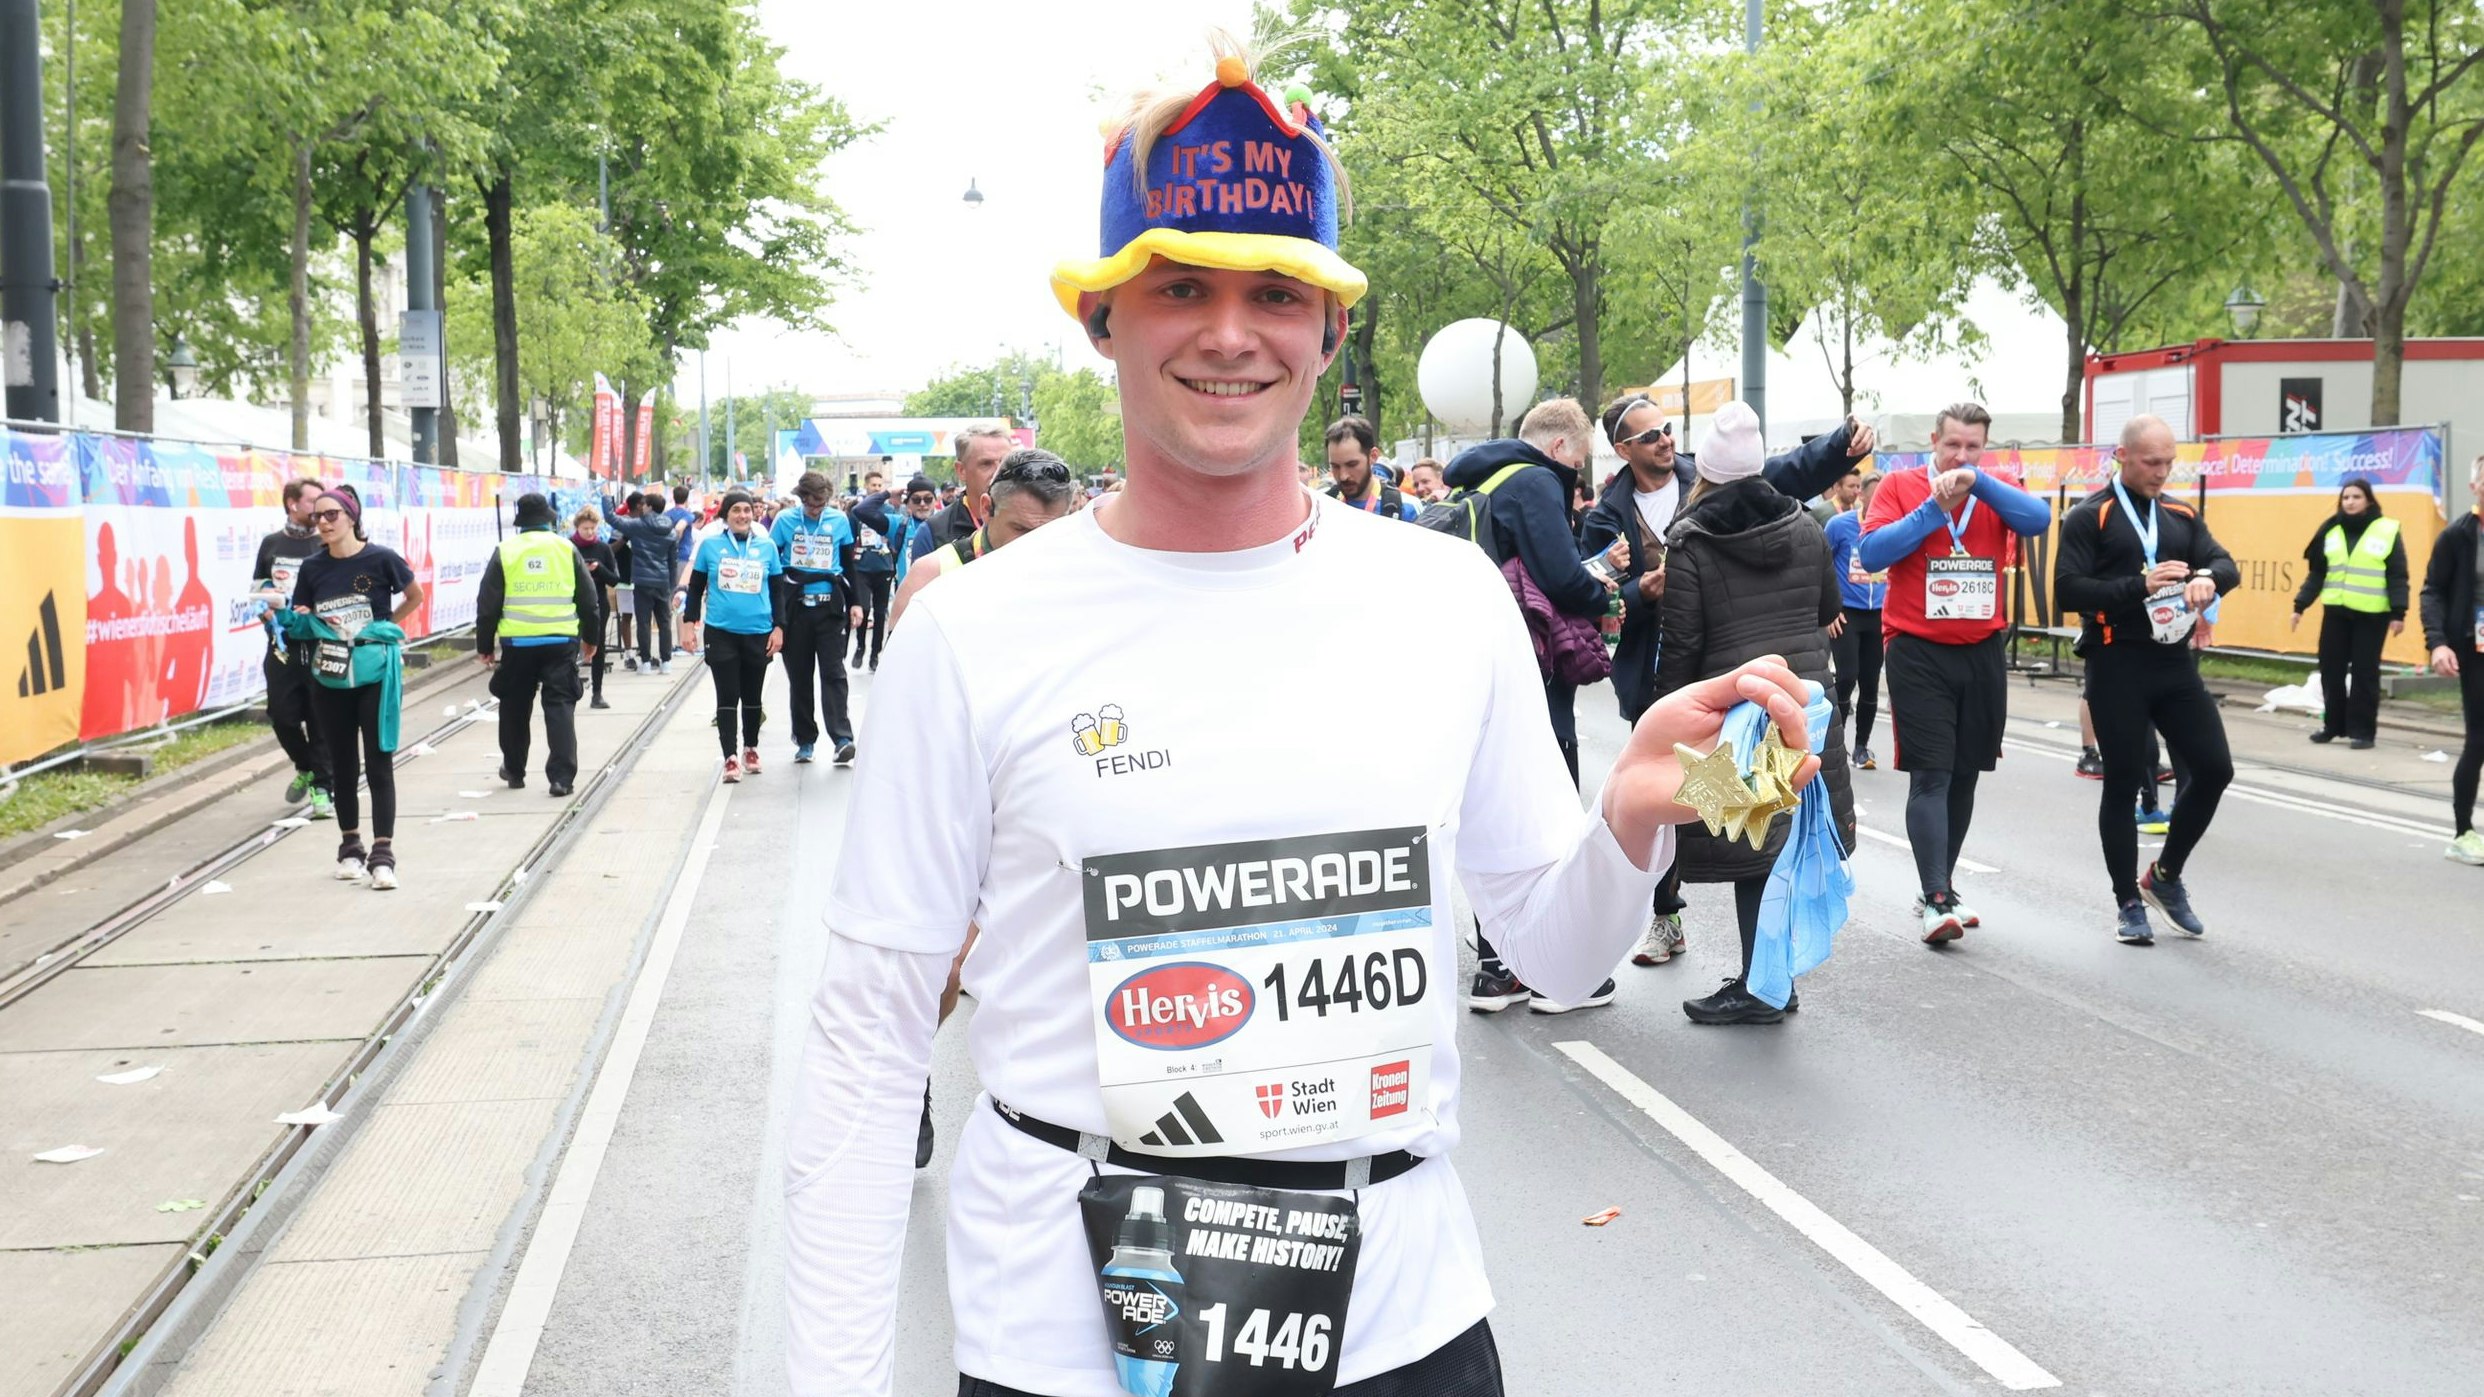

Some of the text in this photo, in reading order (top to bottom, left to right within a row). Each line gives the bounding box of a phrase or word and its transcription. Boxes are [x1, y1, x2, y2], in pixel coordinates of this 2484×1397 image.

[1172, 141, 1292, 178] IT'S MY
[1145, 178, 1315, 220] BIRTHDAY!
[8, 451, 36, 485] the
[2231, 451, 2328, 475] Determination!
[2333, 447, 2395, 471] Success!
[107, 455, 128, 485] Der
[131, 458, 175, 494] Anfang
[527, 560, 542, 569] 62
[1930, 560, 1993, 571] POWERADE
[2237, 559, 2293, 592] THIS
[513, 580, 561, 593] SECURITY
[1961, 581, 1994, 594] 2618C
[316, 594, 368, 613] POWERADE
[321, 659, 347, 674] 2307
[1096, 749, 1172, 779] FENDI
[1127, 923, 1338, 954] POWERADE STAFFELMARATHON 21. APRIL 2024
[1121, 947, 1427, 1029] Hervis 1446D
[1166, 1064, 1188, 1074] Block
[1291, 1077, 1336, 1098] Stadt
[1372, 1070, 1408, 1091] Kronen
[1292, 1098, 1337, 1116] Wien
[1372, 1089, 1408, 1110] Zeitung
[1259, 1120, 1339, 1141] sport.wien.gv.at
[1184, 1196, 1349, 1244] COMPETE, PAUSE,
[1185, 1228, 1345, 1273] MAKE HISTORY!
[1104, 1289, 1168, 1310] POWER
[1122, 1305, 1165, 1325] ADE
[1198, 1302, 1332, 1372] 1446
